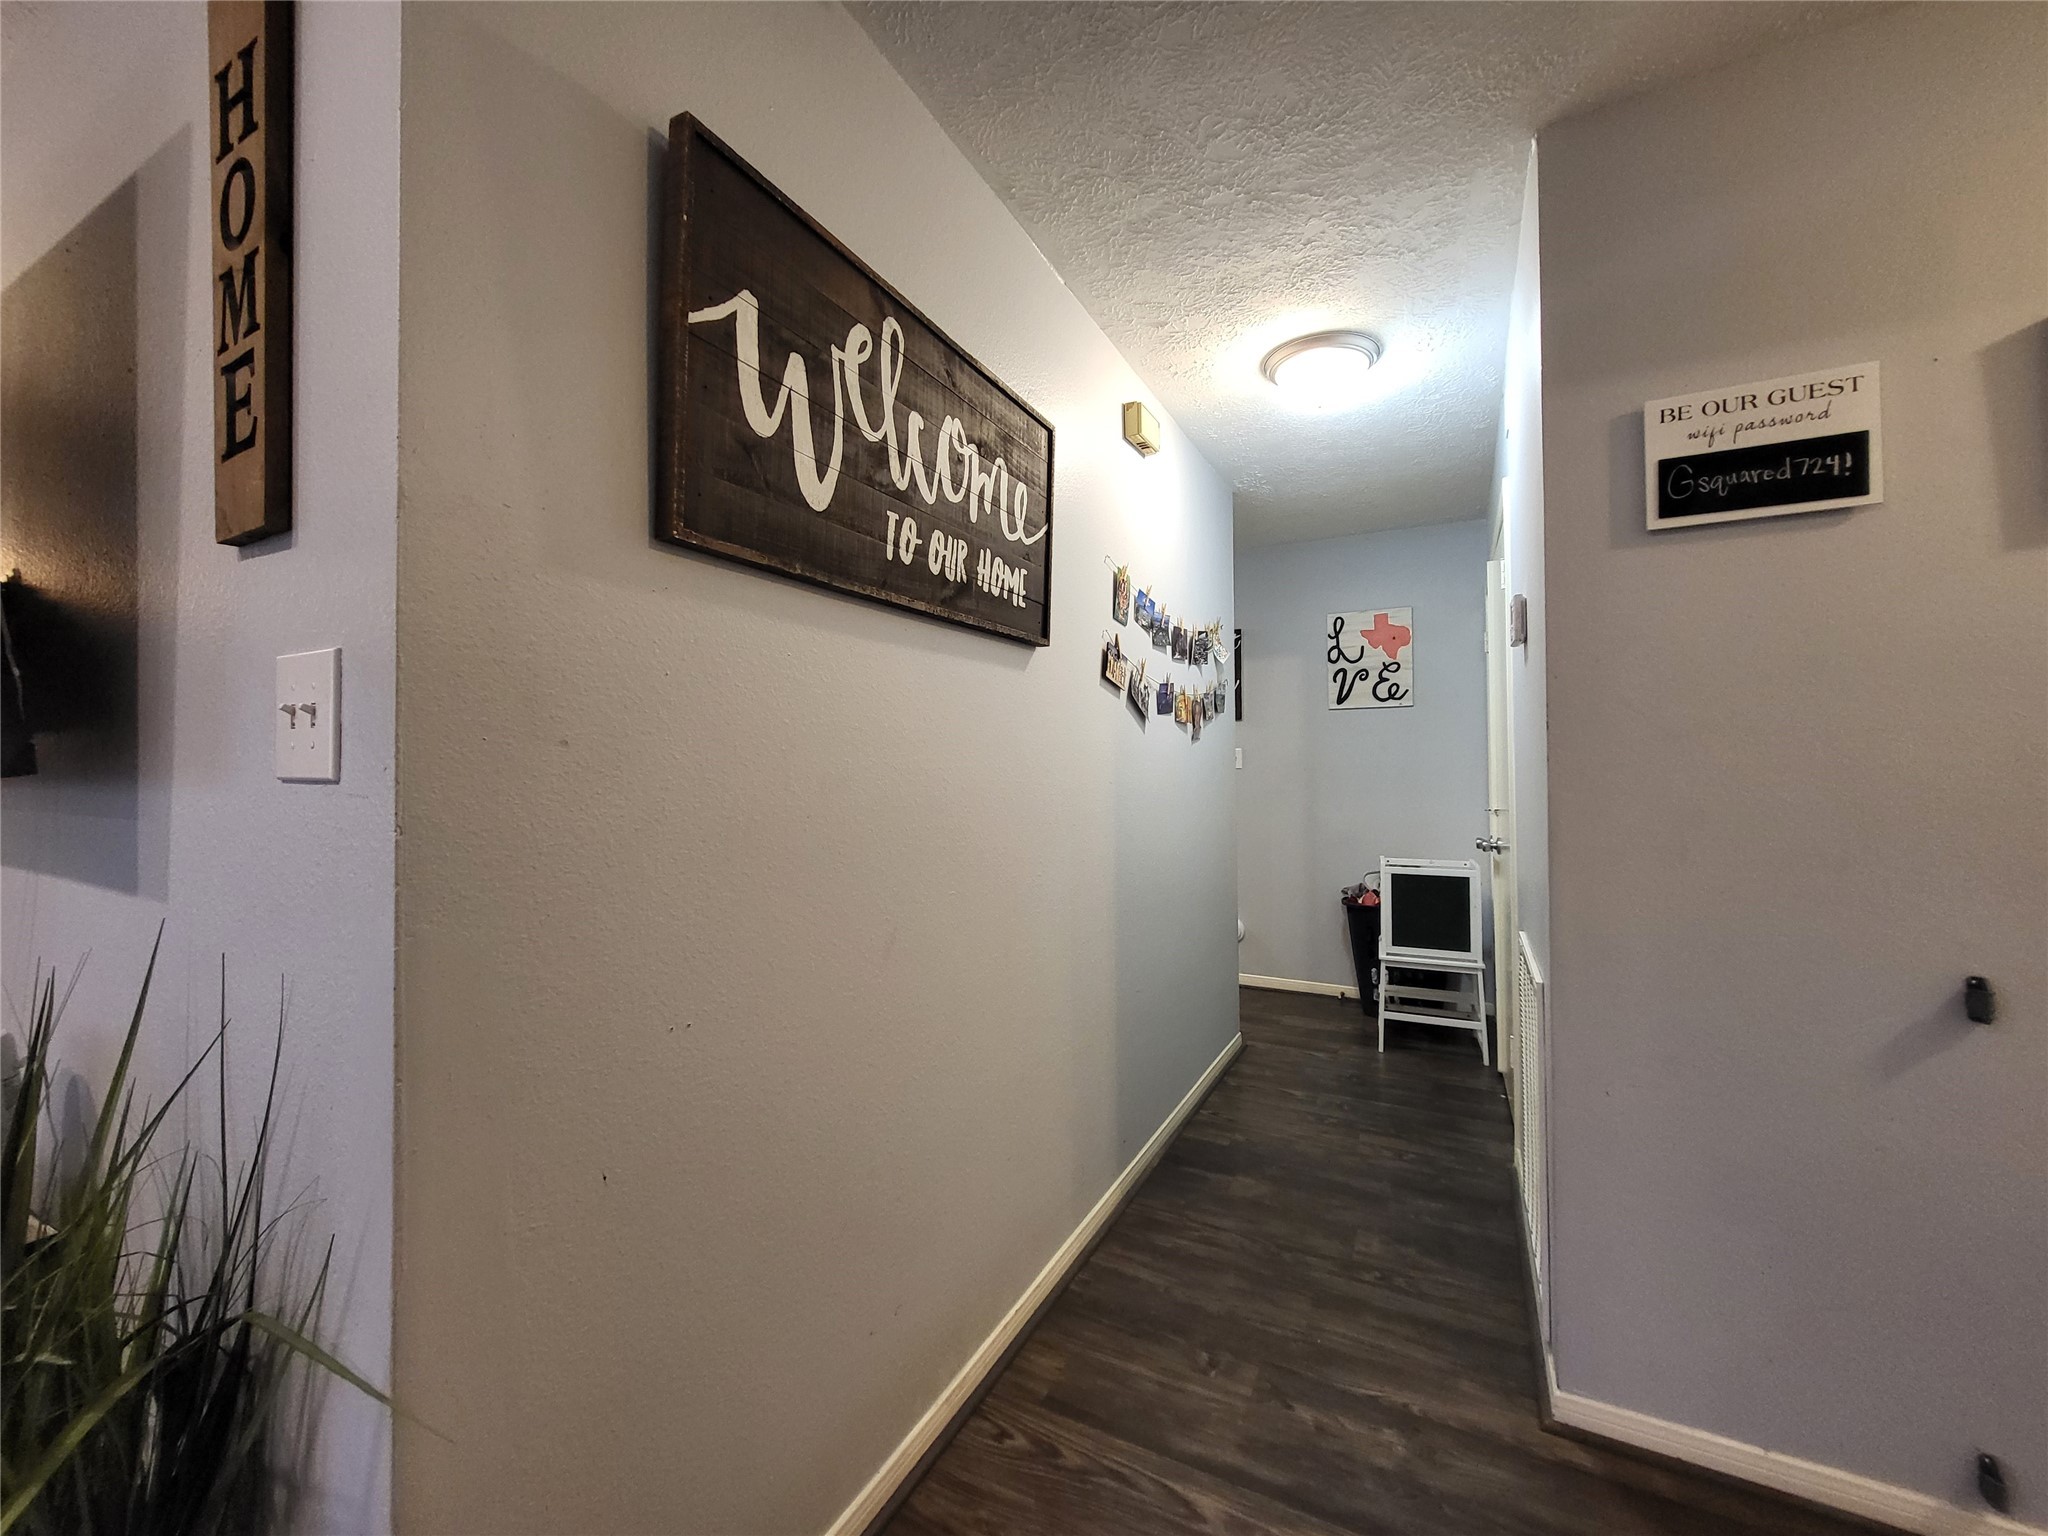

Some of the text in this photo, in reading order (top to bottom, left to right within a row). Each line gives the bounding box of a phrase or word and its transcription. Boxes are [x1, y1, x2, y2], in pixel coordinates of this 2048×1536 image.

[214, 36, 261, 464] HOME
[687, 288, 1050, 546] Welcome
[1659, 374, 1865, 425] BE OUR GUEST
[1686, 400, 1832, 448] wifi password
[886, 510, 1029, 609] TO OUR HOME
